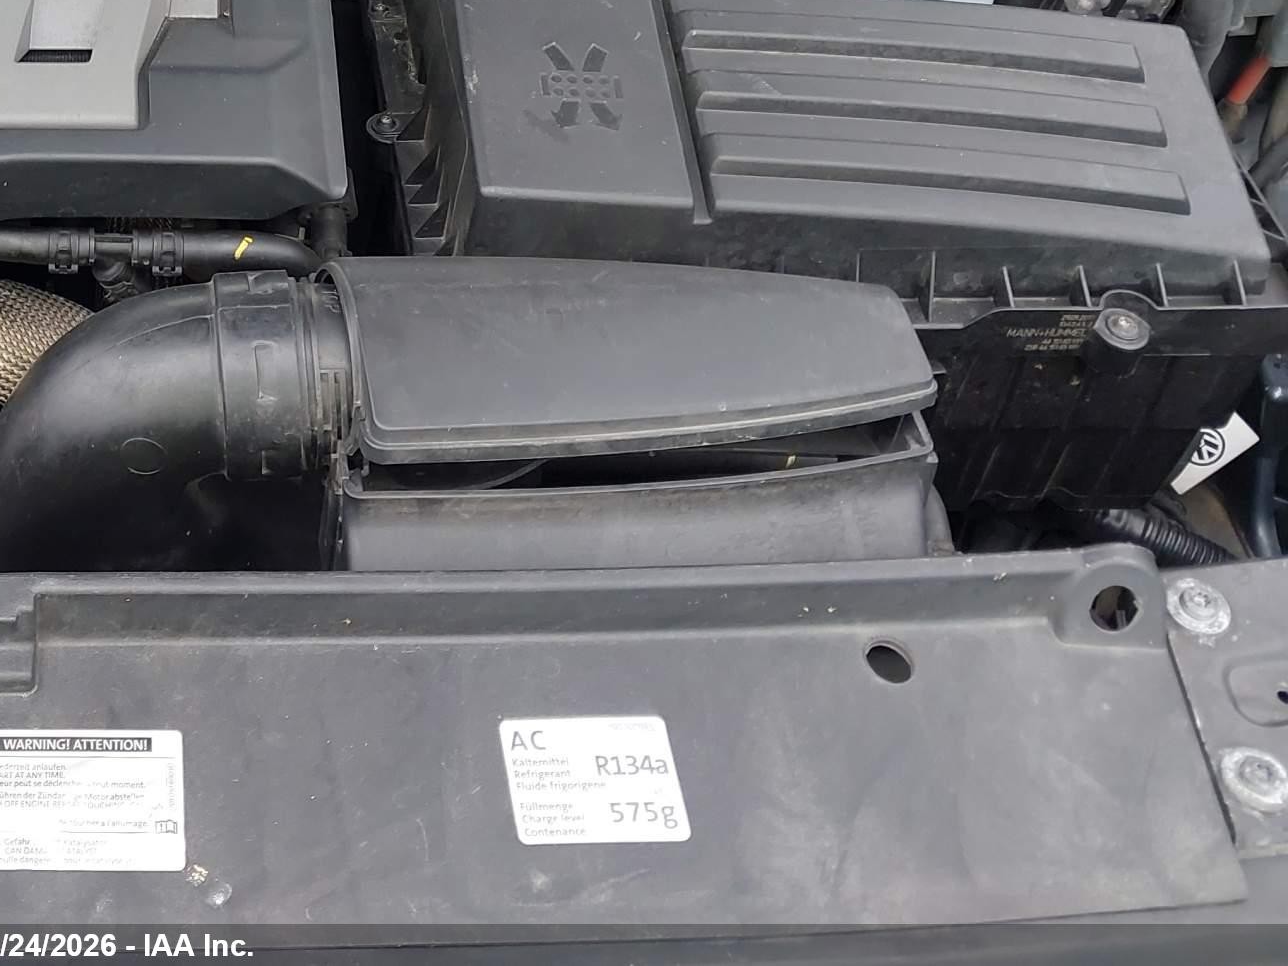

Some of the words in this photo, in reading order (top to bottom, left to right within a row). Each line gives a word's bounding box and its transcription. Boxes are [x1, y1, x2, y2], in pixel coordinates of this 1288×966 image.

[4, 739, 70, 750] WARNING!
[74, 739, 147, 750] ATTENTION!
[595, 755, 669, 776] R134a
[514, 770, 570, 780] Refrigerant
[517, 782, 547, 791] Fluide
[524, 828, 586, 837] Contenance
